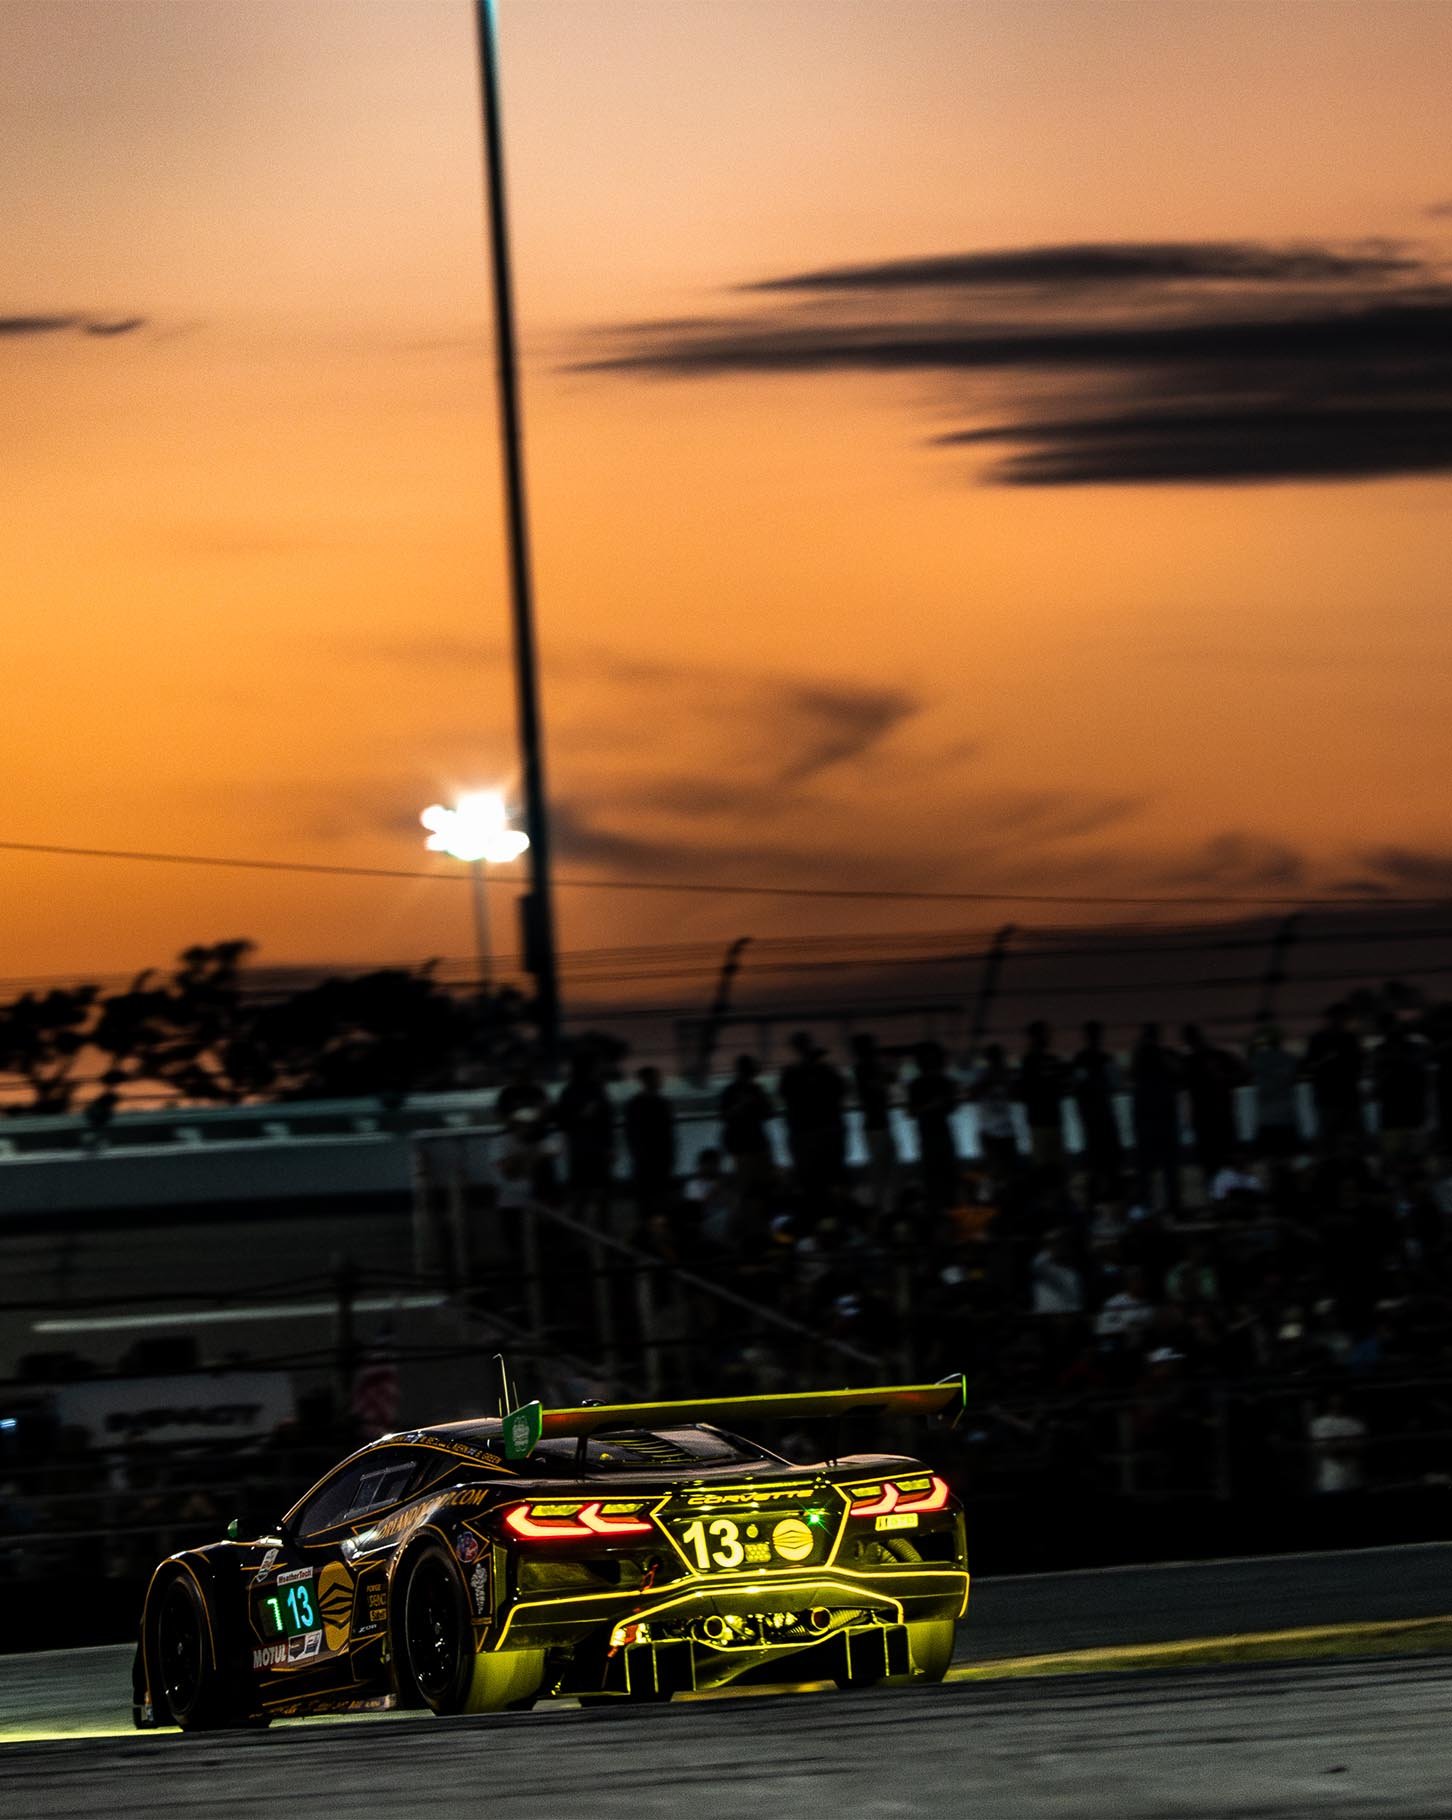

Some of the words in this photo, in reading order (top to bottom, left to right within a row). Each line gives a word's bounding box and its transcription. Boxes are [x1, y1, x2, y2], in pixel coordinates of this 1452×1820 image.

[682, 1519, 744, 1569] 13
[278, 1567, 312, 1583] WeatherTech
[287, 1585, 314, 1629] 13
[253, 1644, 287, 1669] MOTUL
